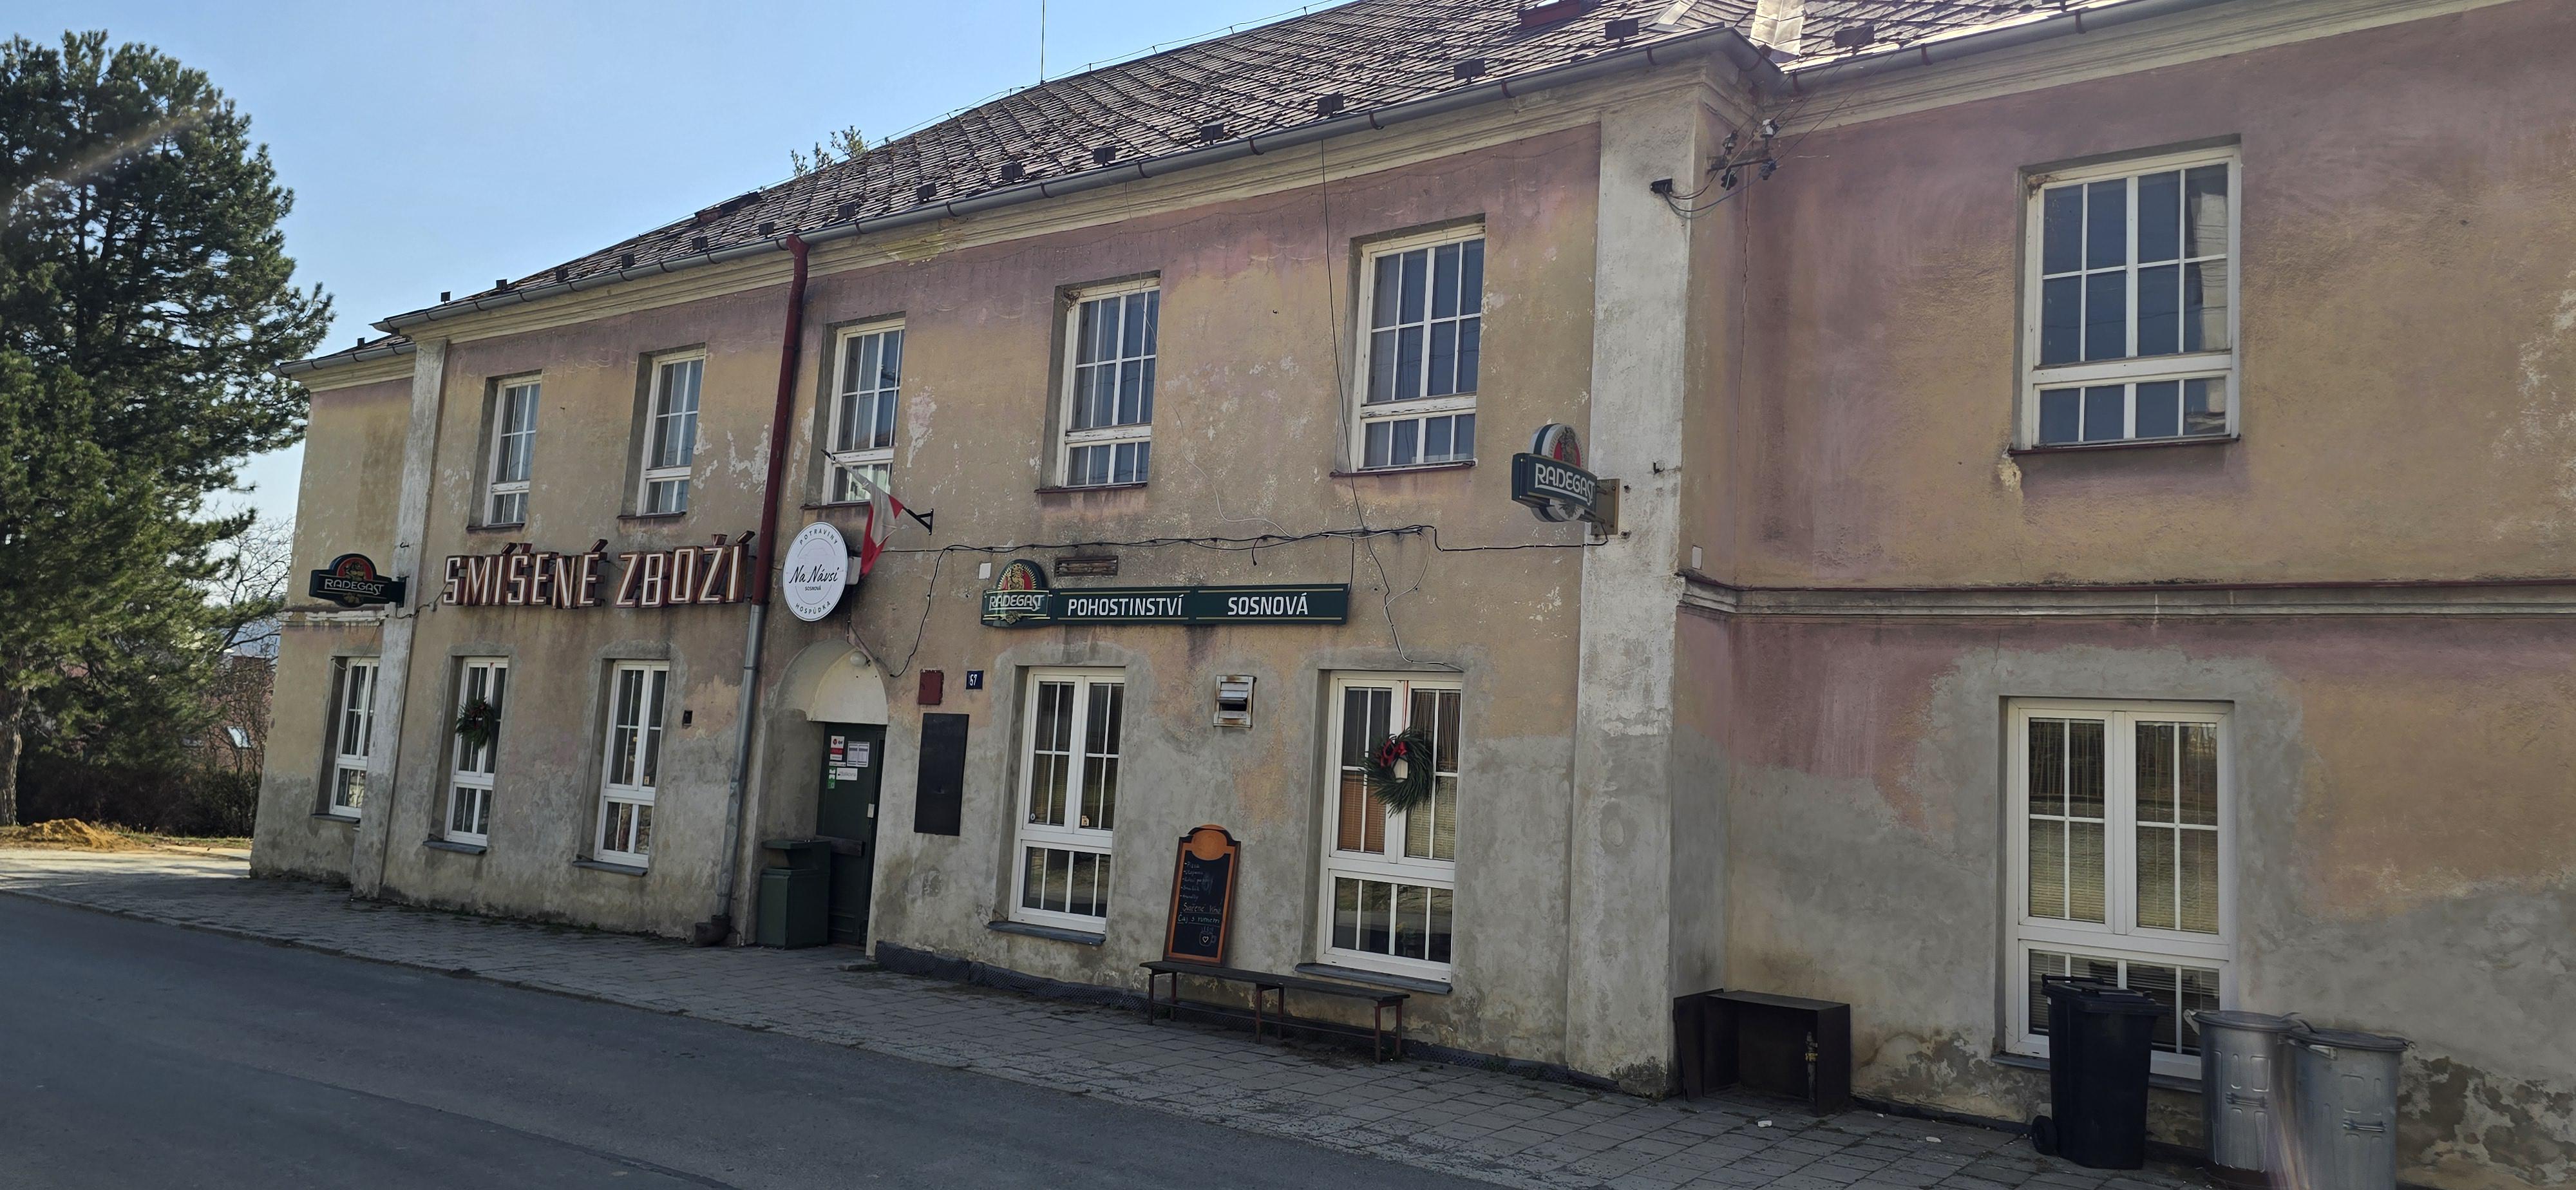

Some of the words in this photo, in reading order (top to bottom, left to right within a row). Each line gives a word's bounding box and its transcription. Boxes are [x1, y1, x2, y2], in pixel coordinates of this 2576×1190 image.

[1535, 462, 1595, 506] RADEGAST
[799, 528, 838, 545] POTRAVINY
[440, 539, 608, 609] SMÍŠENÉ
[614, 531, 755, 608] ZBOŽÍ
[789, 565, 806, 583] Na
[324, 578, 384, 596] RADEGAST
[989, 594, 1045, 612] RADEGAST
[1067, 594, 1184, 616] POHOSTINSTVÍ
[1227, 592, 1308, 616] SOSNOVÁ
[1178, 912, 1188, 923] Čaj
